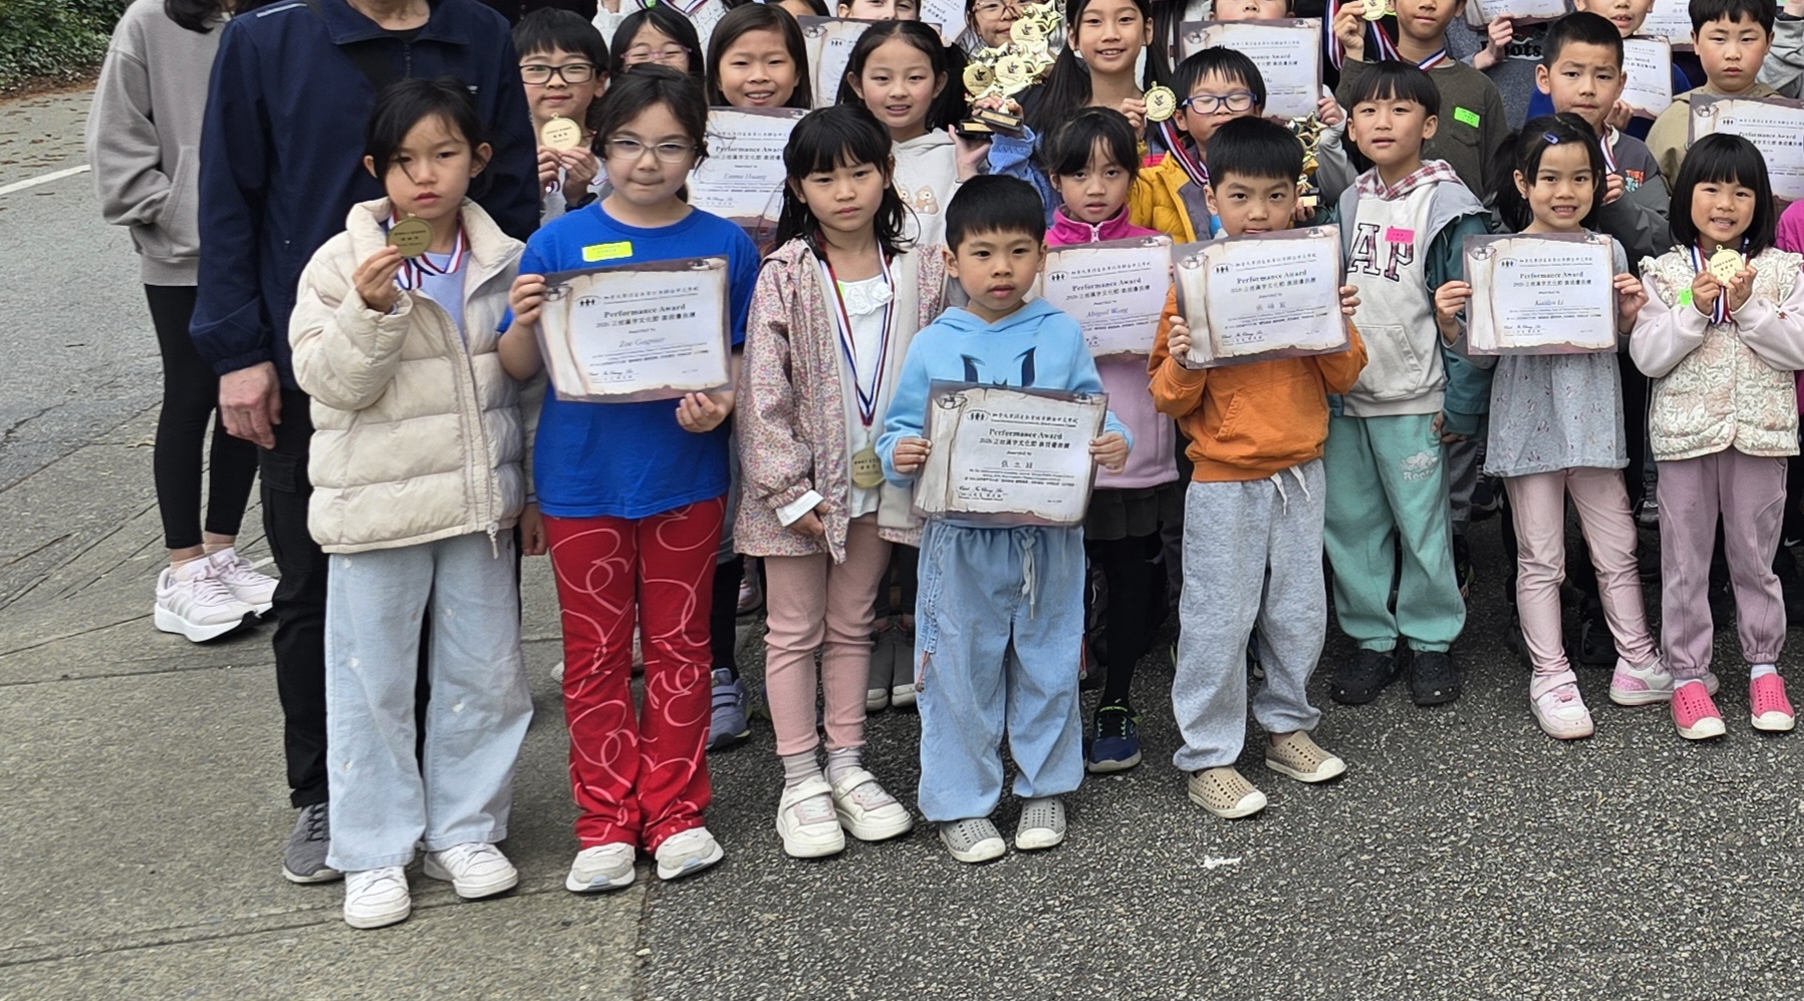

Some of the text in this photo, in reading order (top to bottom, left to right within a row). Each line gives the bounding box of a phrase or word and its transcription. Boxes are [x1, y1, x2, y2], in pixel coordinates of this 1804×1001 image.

[604, 303, 686, 318] Performance Award
[989, 427, 1037, 439] Performance
